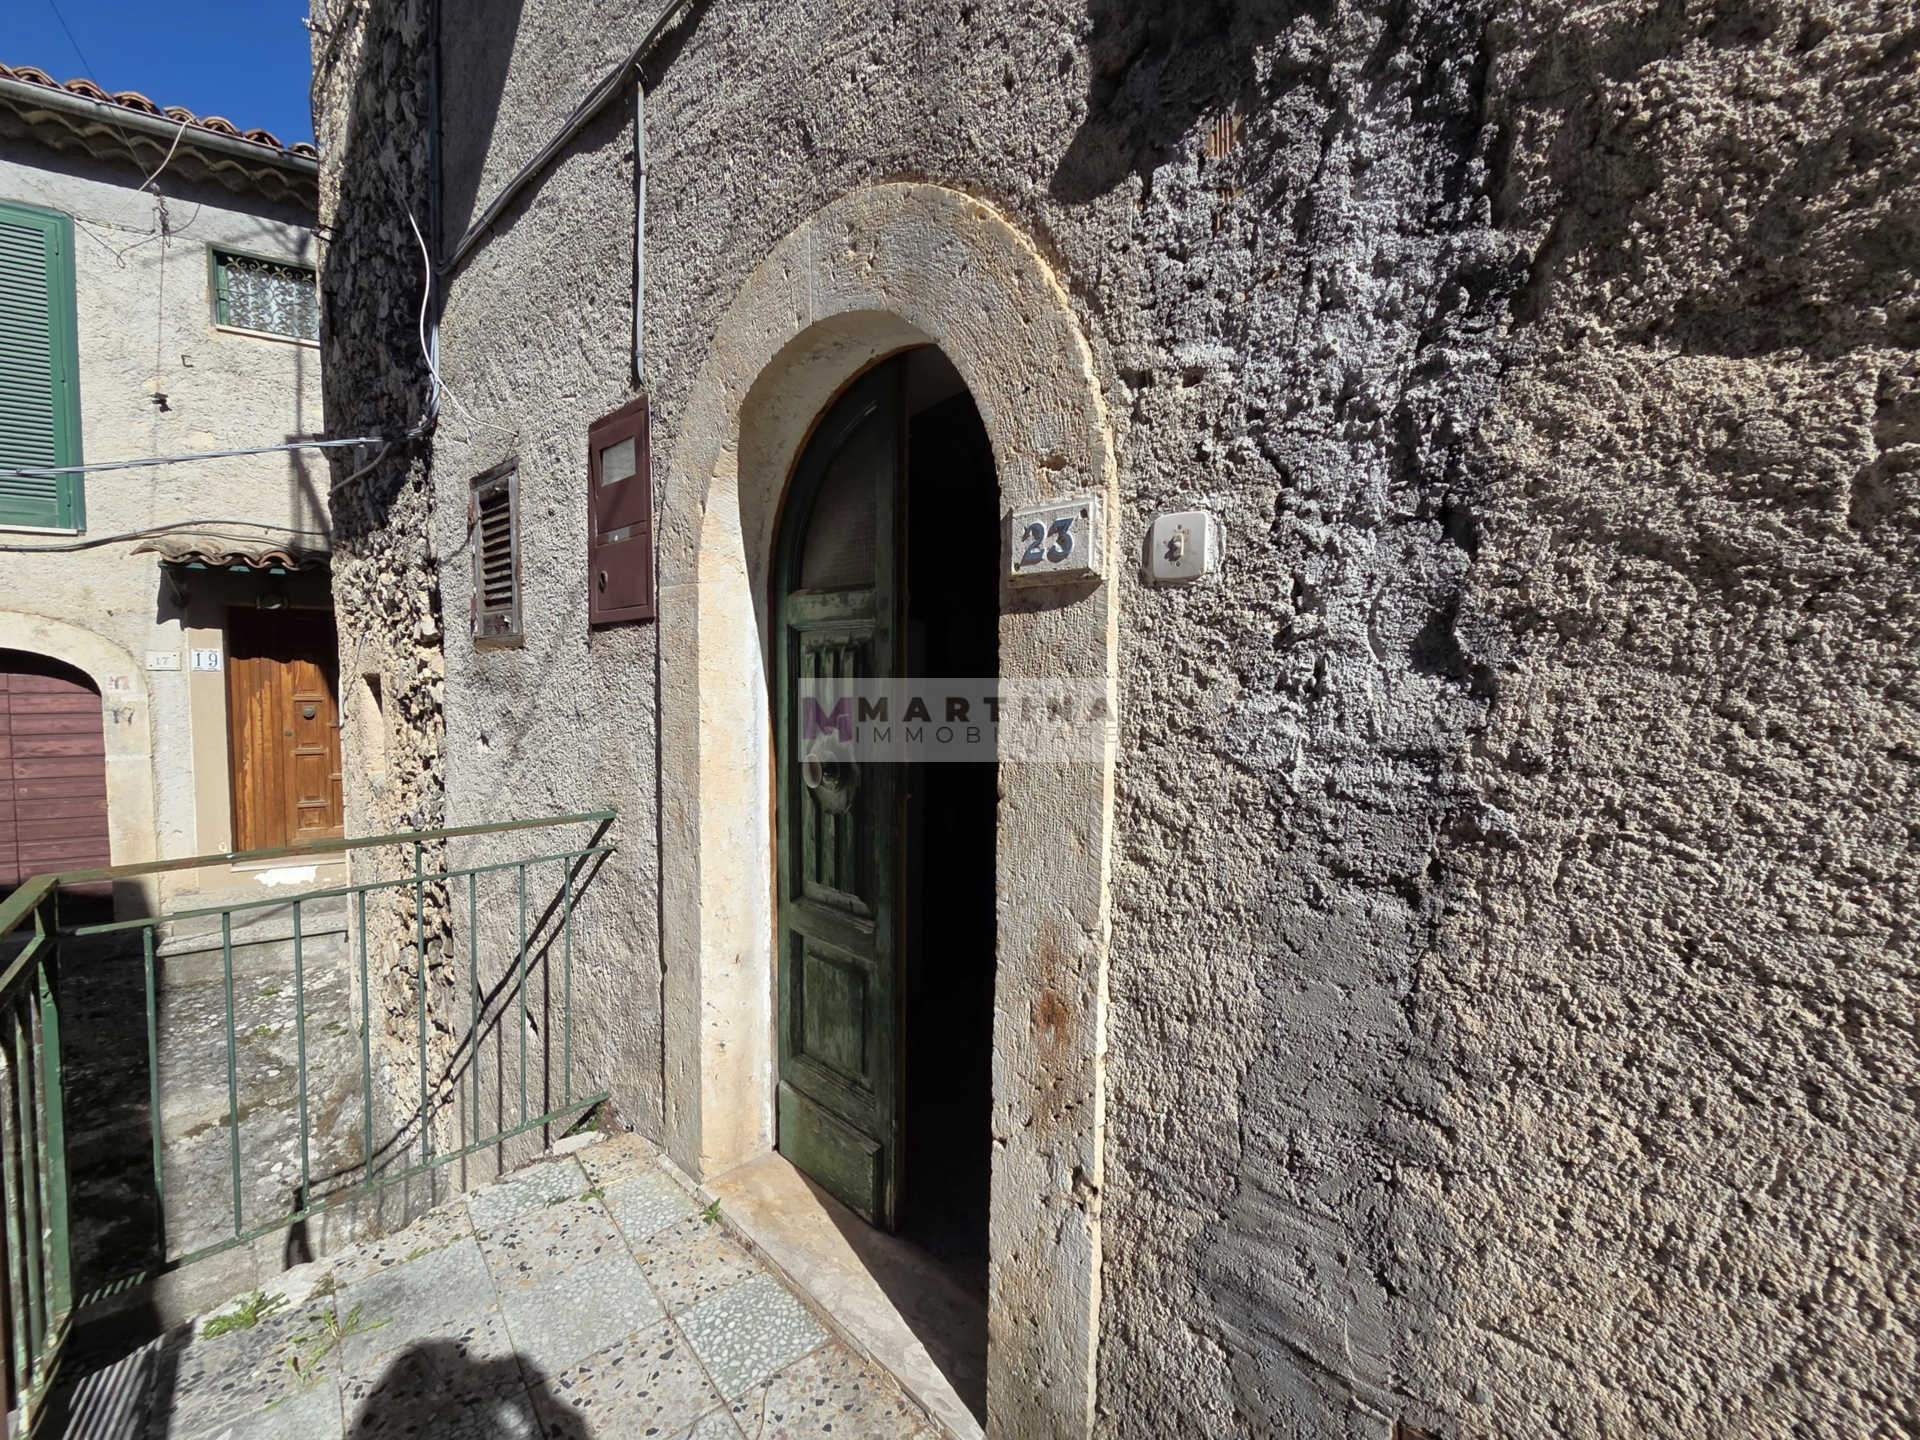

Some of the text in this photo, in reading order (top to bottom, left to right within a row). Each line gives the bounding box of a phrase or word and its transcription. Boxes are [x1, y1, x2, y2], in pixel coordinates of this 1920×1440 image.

[1020, 517, 1076, 564] 23
[156, 656, 171, 666] 17
[196, 652, 219, 667] 19
